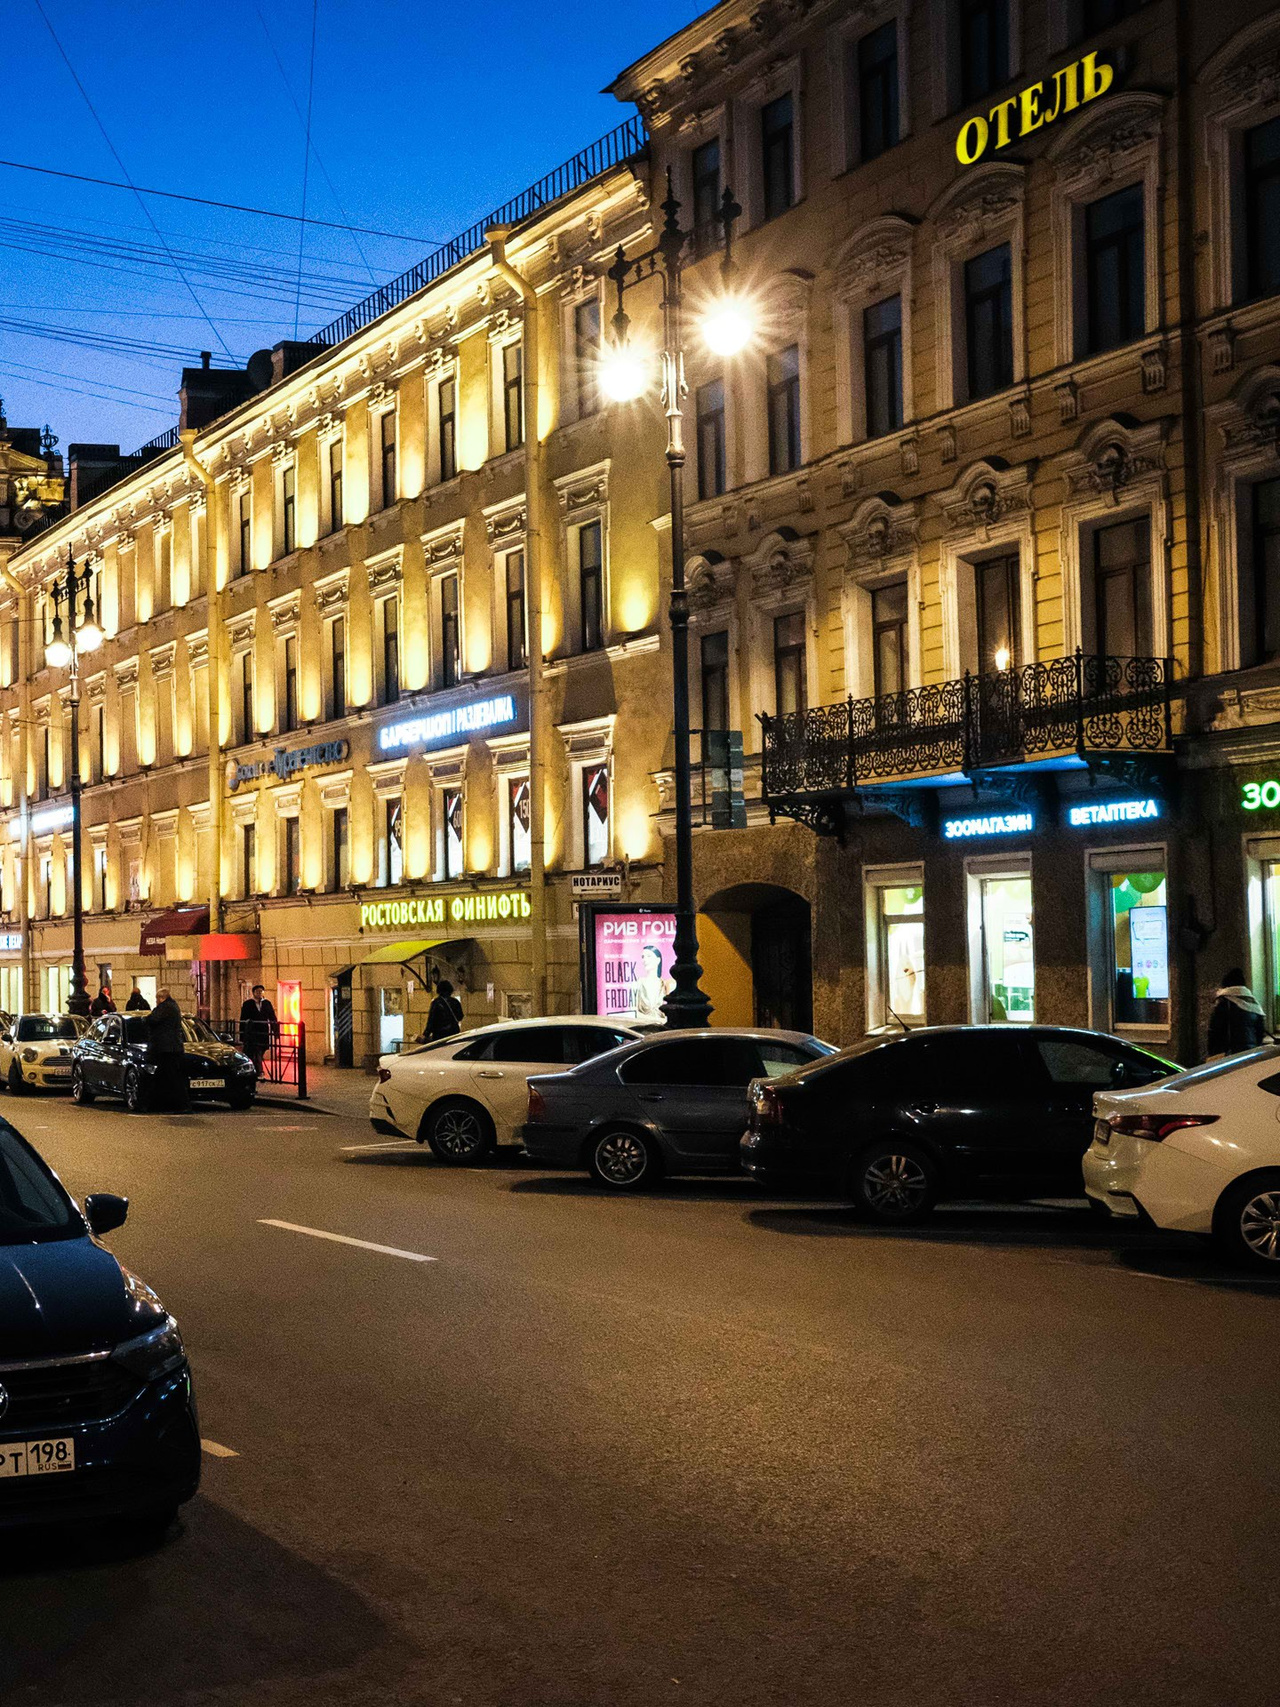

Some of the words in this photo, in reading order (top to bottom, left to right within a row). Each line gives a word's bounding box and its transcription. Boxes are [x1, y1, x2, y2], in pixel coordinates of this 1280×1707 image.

[956, 51, 1114, 165] ОТЕЛЬ
[1069, 799, 1158, 826] ВЕТАПТЕКА
[944, 813, 1033, 839] ЗООМАГАЗИН
[573, 876, 620, 887] НОТАРИУС
[361, 899, 444, 927] РОСТОВСКАЯ
[451, 893, 531, 921] ФИНИФТЬ
[603, 922, 638, 936] РИВ
[605, 961, 637, 983] BLACK
[606, 988, 638, 1008] FRIDAY
[30, 1441, 68, 1464] 198
[38, 1462, 57, 1471] RUS
